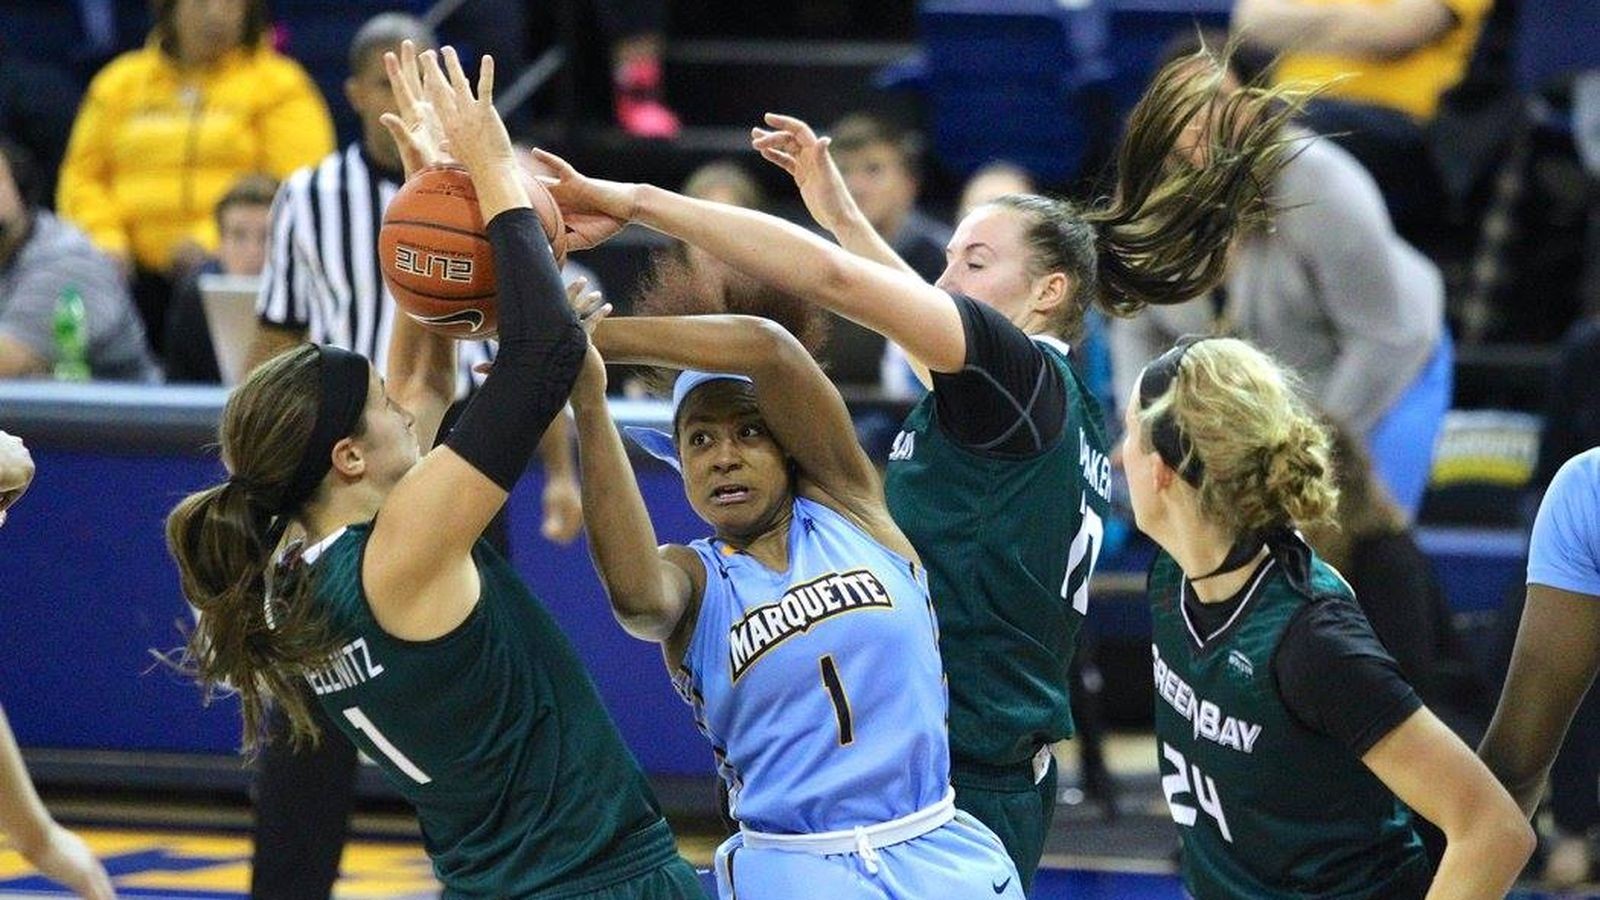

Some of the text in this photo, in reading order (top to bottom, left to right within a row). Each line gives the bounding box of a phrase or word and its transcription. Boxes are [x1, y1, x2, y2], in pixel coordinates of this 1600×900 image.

[395, 246, 474, 284] ELITE
[728, 570, 893, 682] MARQUETTE
[342, 706, 432, 785] 1
[818, 653, 854, 747] 1
[1161, 741, 1234, 843] 24
